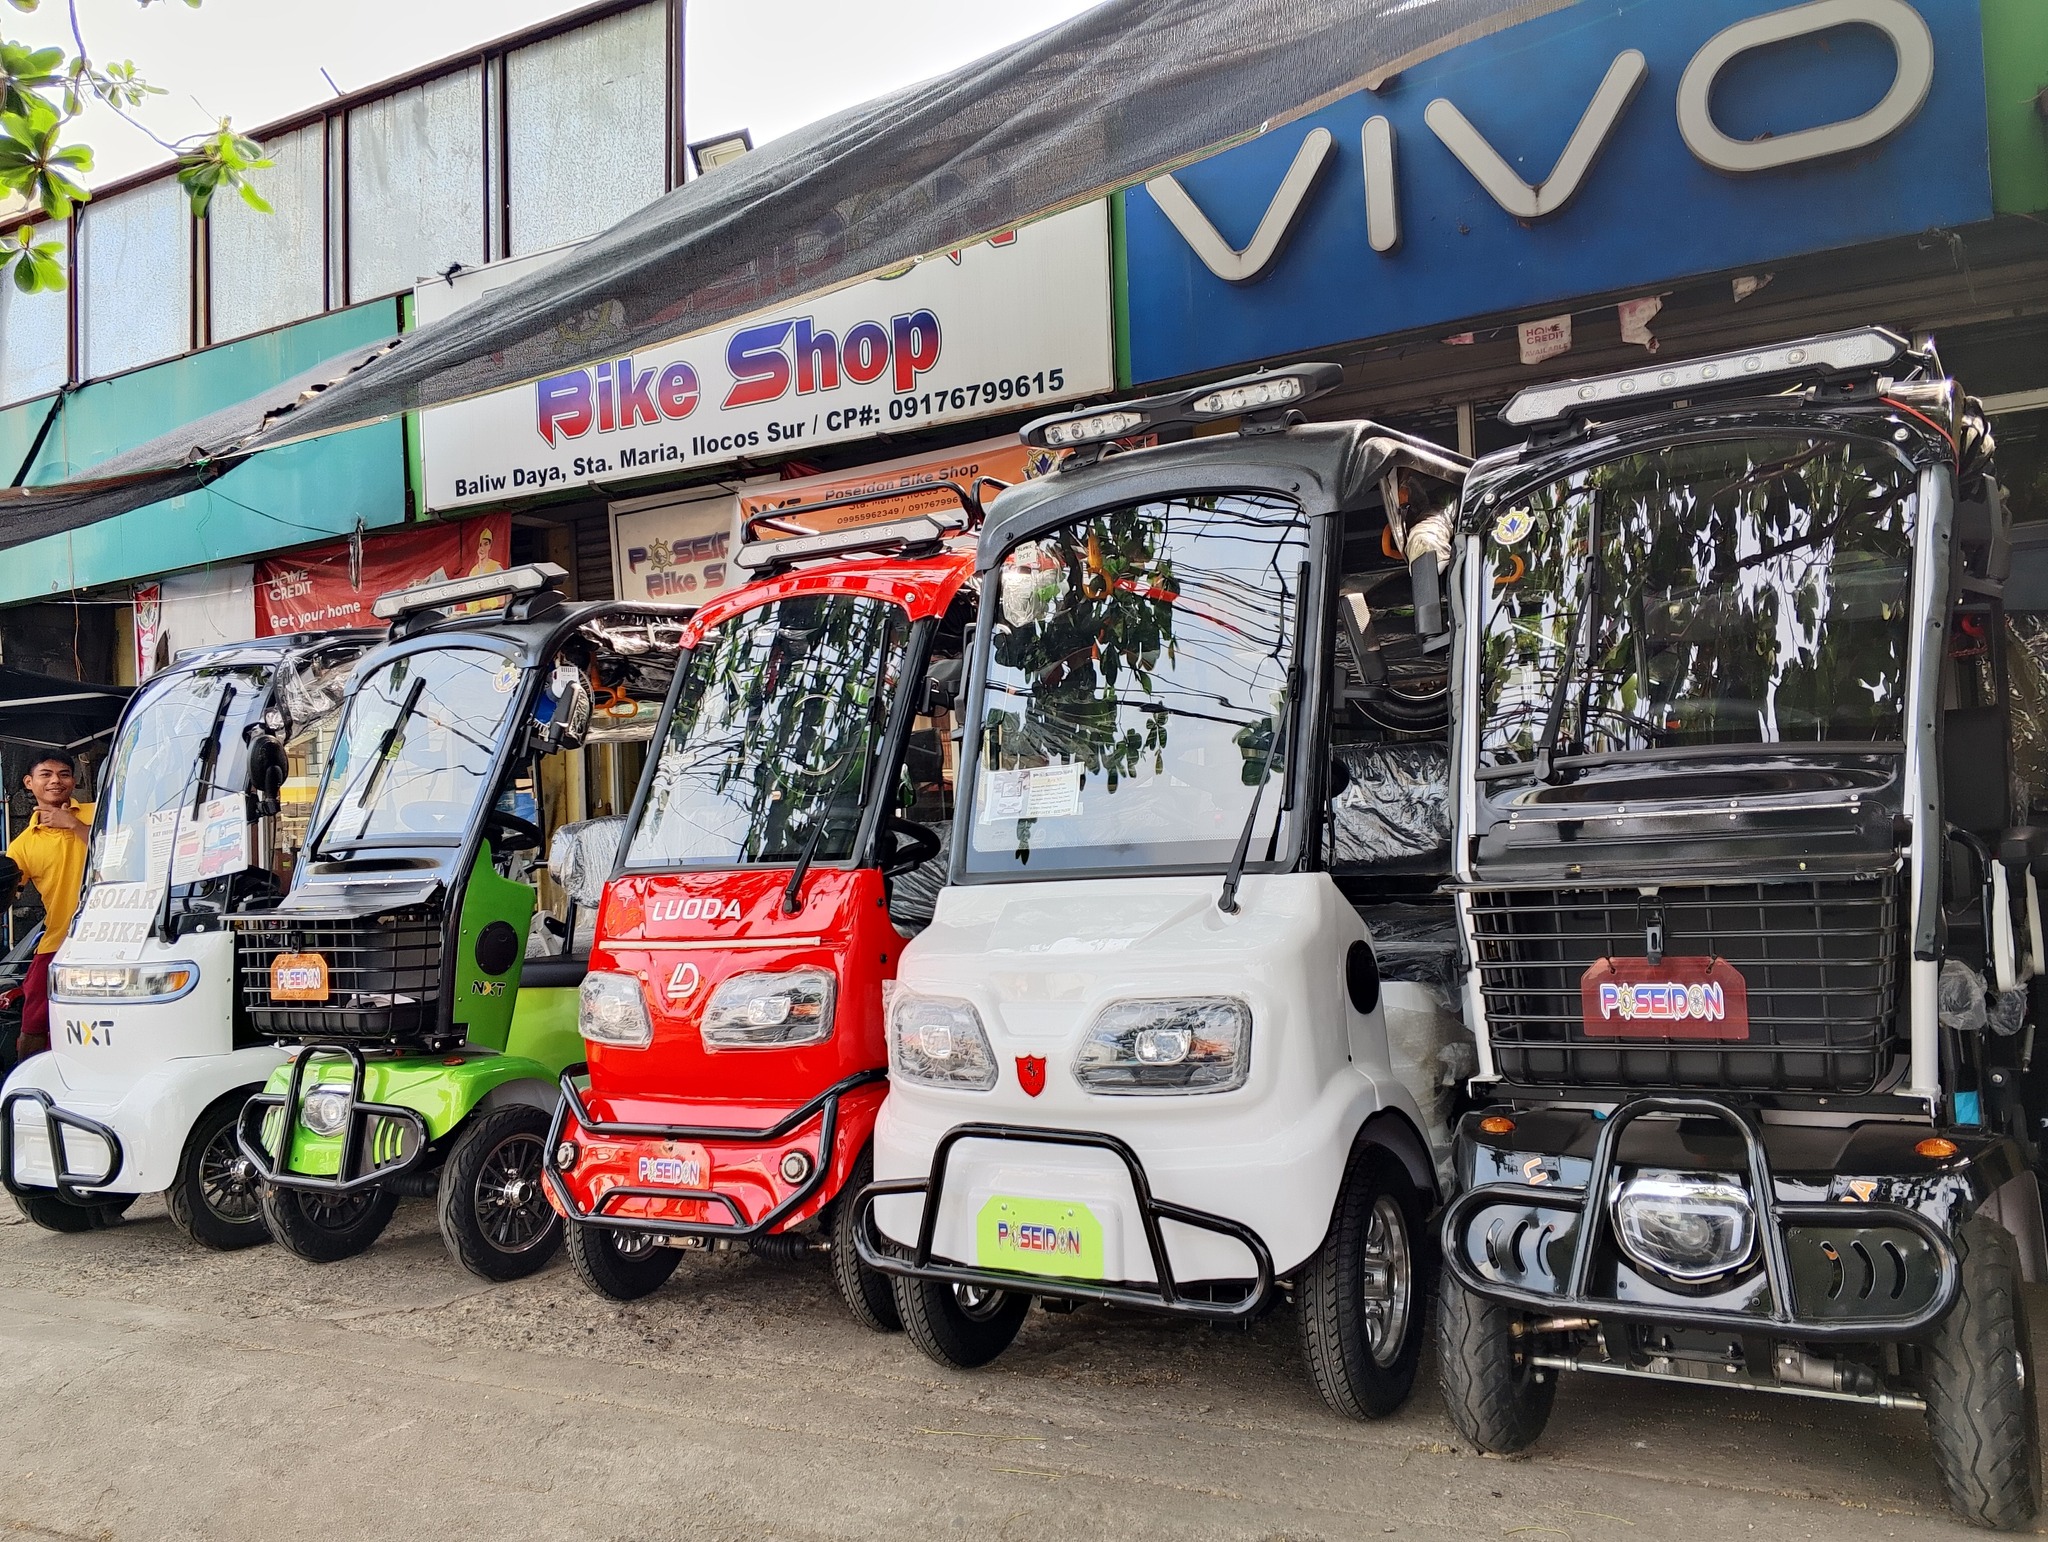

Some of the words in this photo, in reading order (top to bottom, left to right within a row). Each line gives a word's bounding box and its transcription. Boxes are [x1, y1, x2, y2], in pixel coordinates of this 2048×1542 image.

[1526, 323, 1560, 337] HOME
[1526, 331, 1564, 345] CREDIT
[535, 355, 701, 449] Bike
[720, 308, 942, 411] Shop
[455, 475, 506, 498] Baliw
[513, 466, 567, 488] Daya,
[573, 457, 613, 477] Sta.
[620, 444, 685, 469] Maria,
[692, 431, 759, 456] Ilocos
[767, 421, 805, 442] Sur
[812, 414, 819, 435] /
[826, 404, 881, 431] CP#:
[889, 368, 1064, 421] 09176799615
[825, 482, 894, 501] Poseidon
[900, 473, 934, 488] Bike
[939, 463, 979, 480] Shop
[837, 508, 899, 525] 09955962349
[271, 569, 309, 587] HOME
[646, 571, 698, 599] Bike
[269, 581, 313, 601] CREDIT
[270, 613, 295, 629] Get
[297, 609, 325, 628] your
[327, 602, 361, 618] home
[91, 888, 158, 910] SOLAR
[652, 898, 742, 921] LUODA
[76, 921, 148, 944] E-BIKE
[277, 966, 321, 989] POSEIDON
[471, 980, 506, 997] NXT
[1600, 981, 1725, 1021] POSEIDON
[66, 1020, 114, 1047] NXT
[638, 1156, 700, 1187] POSEIDON
[997, 1220, 1081, 1258] POSEIDON
